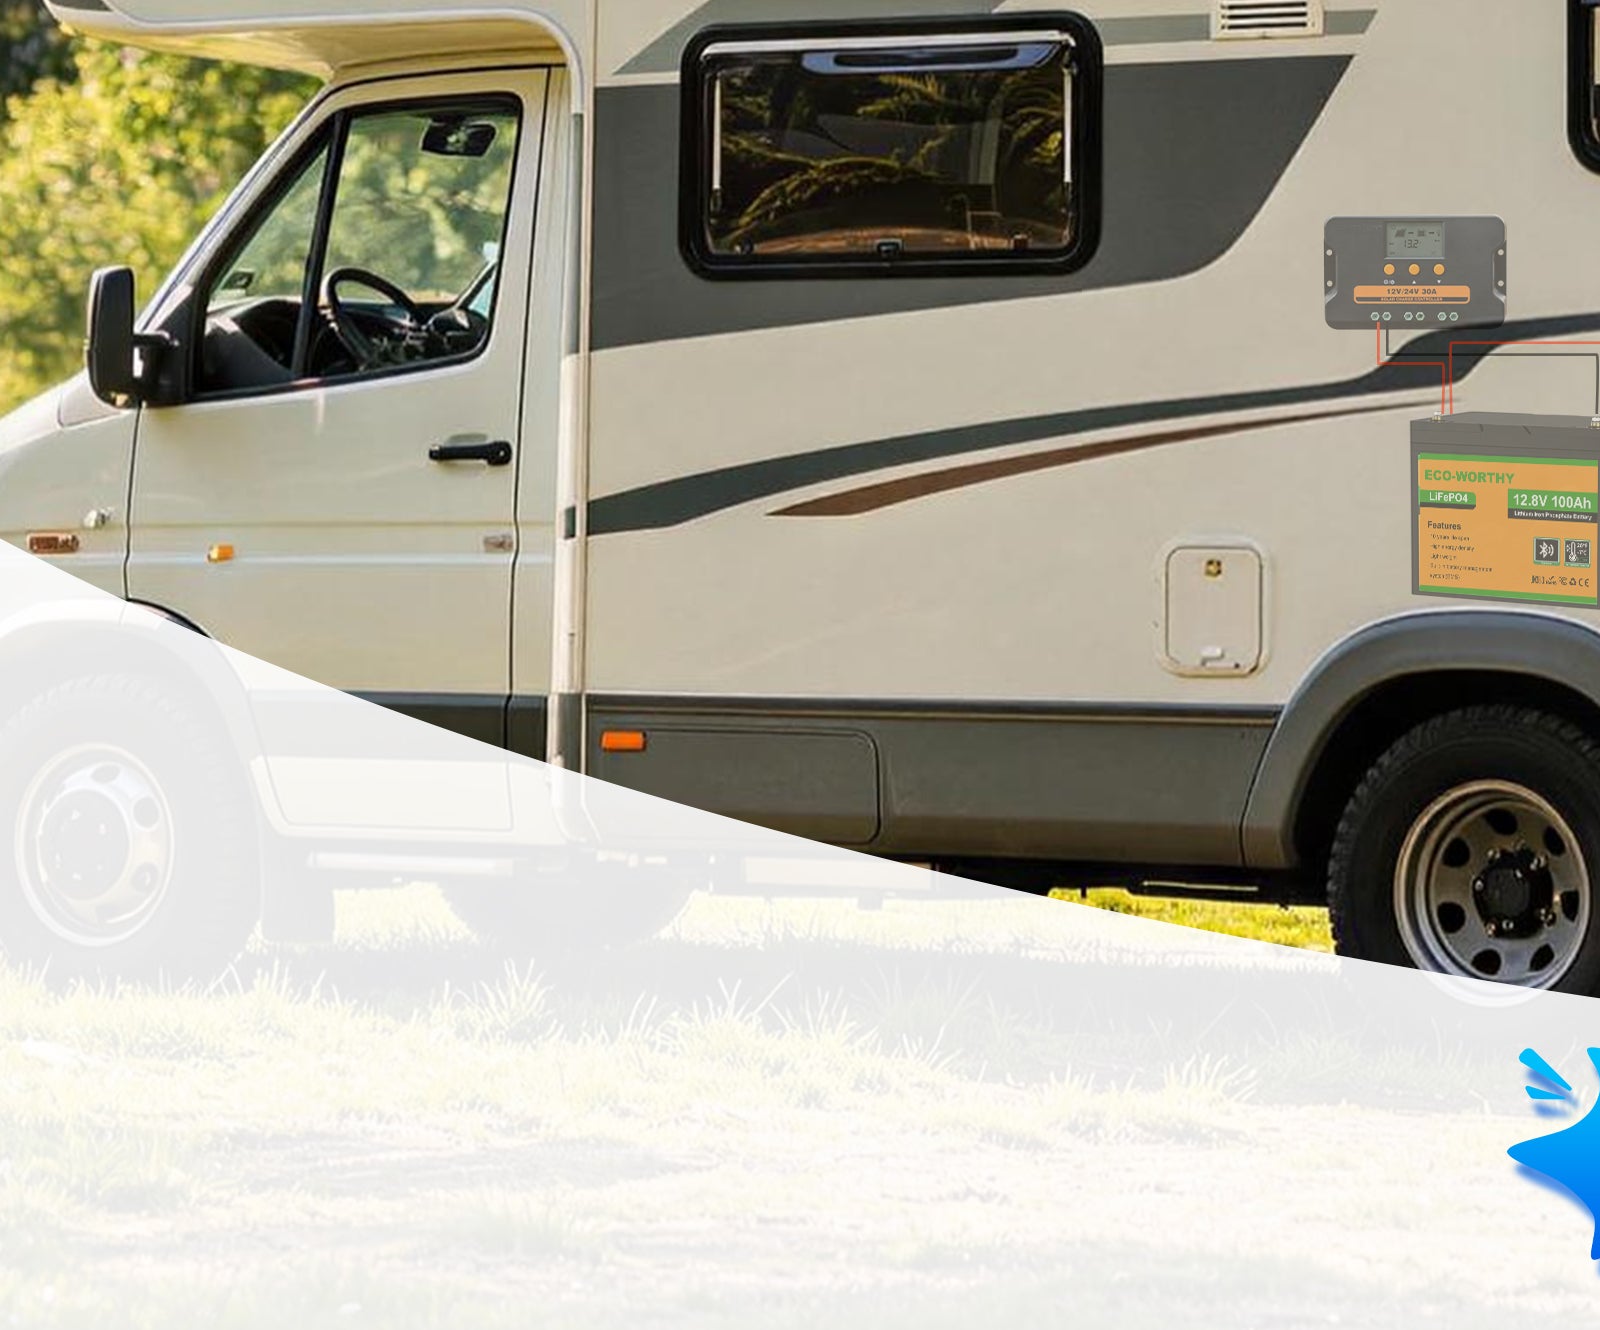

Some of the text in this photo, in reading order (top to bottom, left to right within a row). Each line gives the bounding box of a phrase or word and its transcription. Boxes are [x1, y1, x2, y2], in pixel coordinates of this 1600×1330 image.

[1424, 469, 1515, 484] ECO-WORTHY
[1429, 491, 1468, 503] LiFePO4
[1513, 494, 1592, 510] 12.8V 100Ah
[1427, 520, 1462, 530] Features
